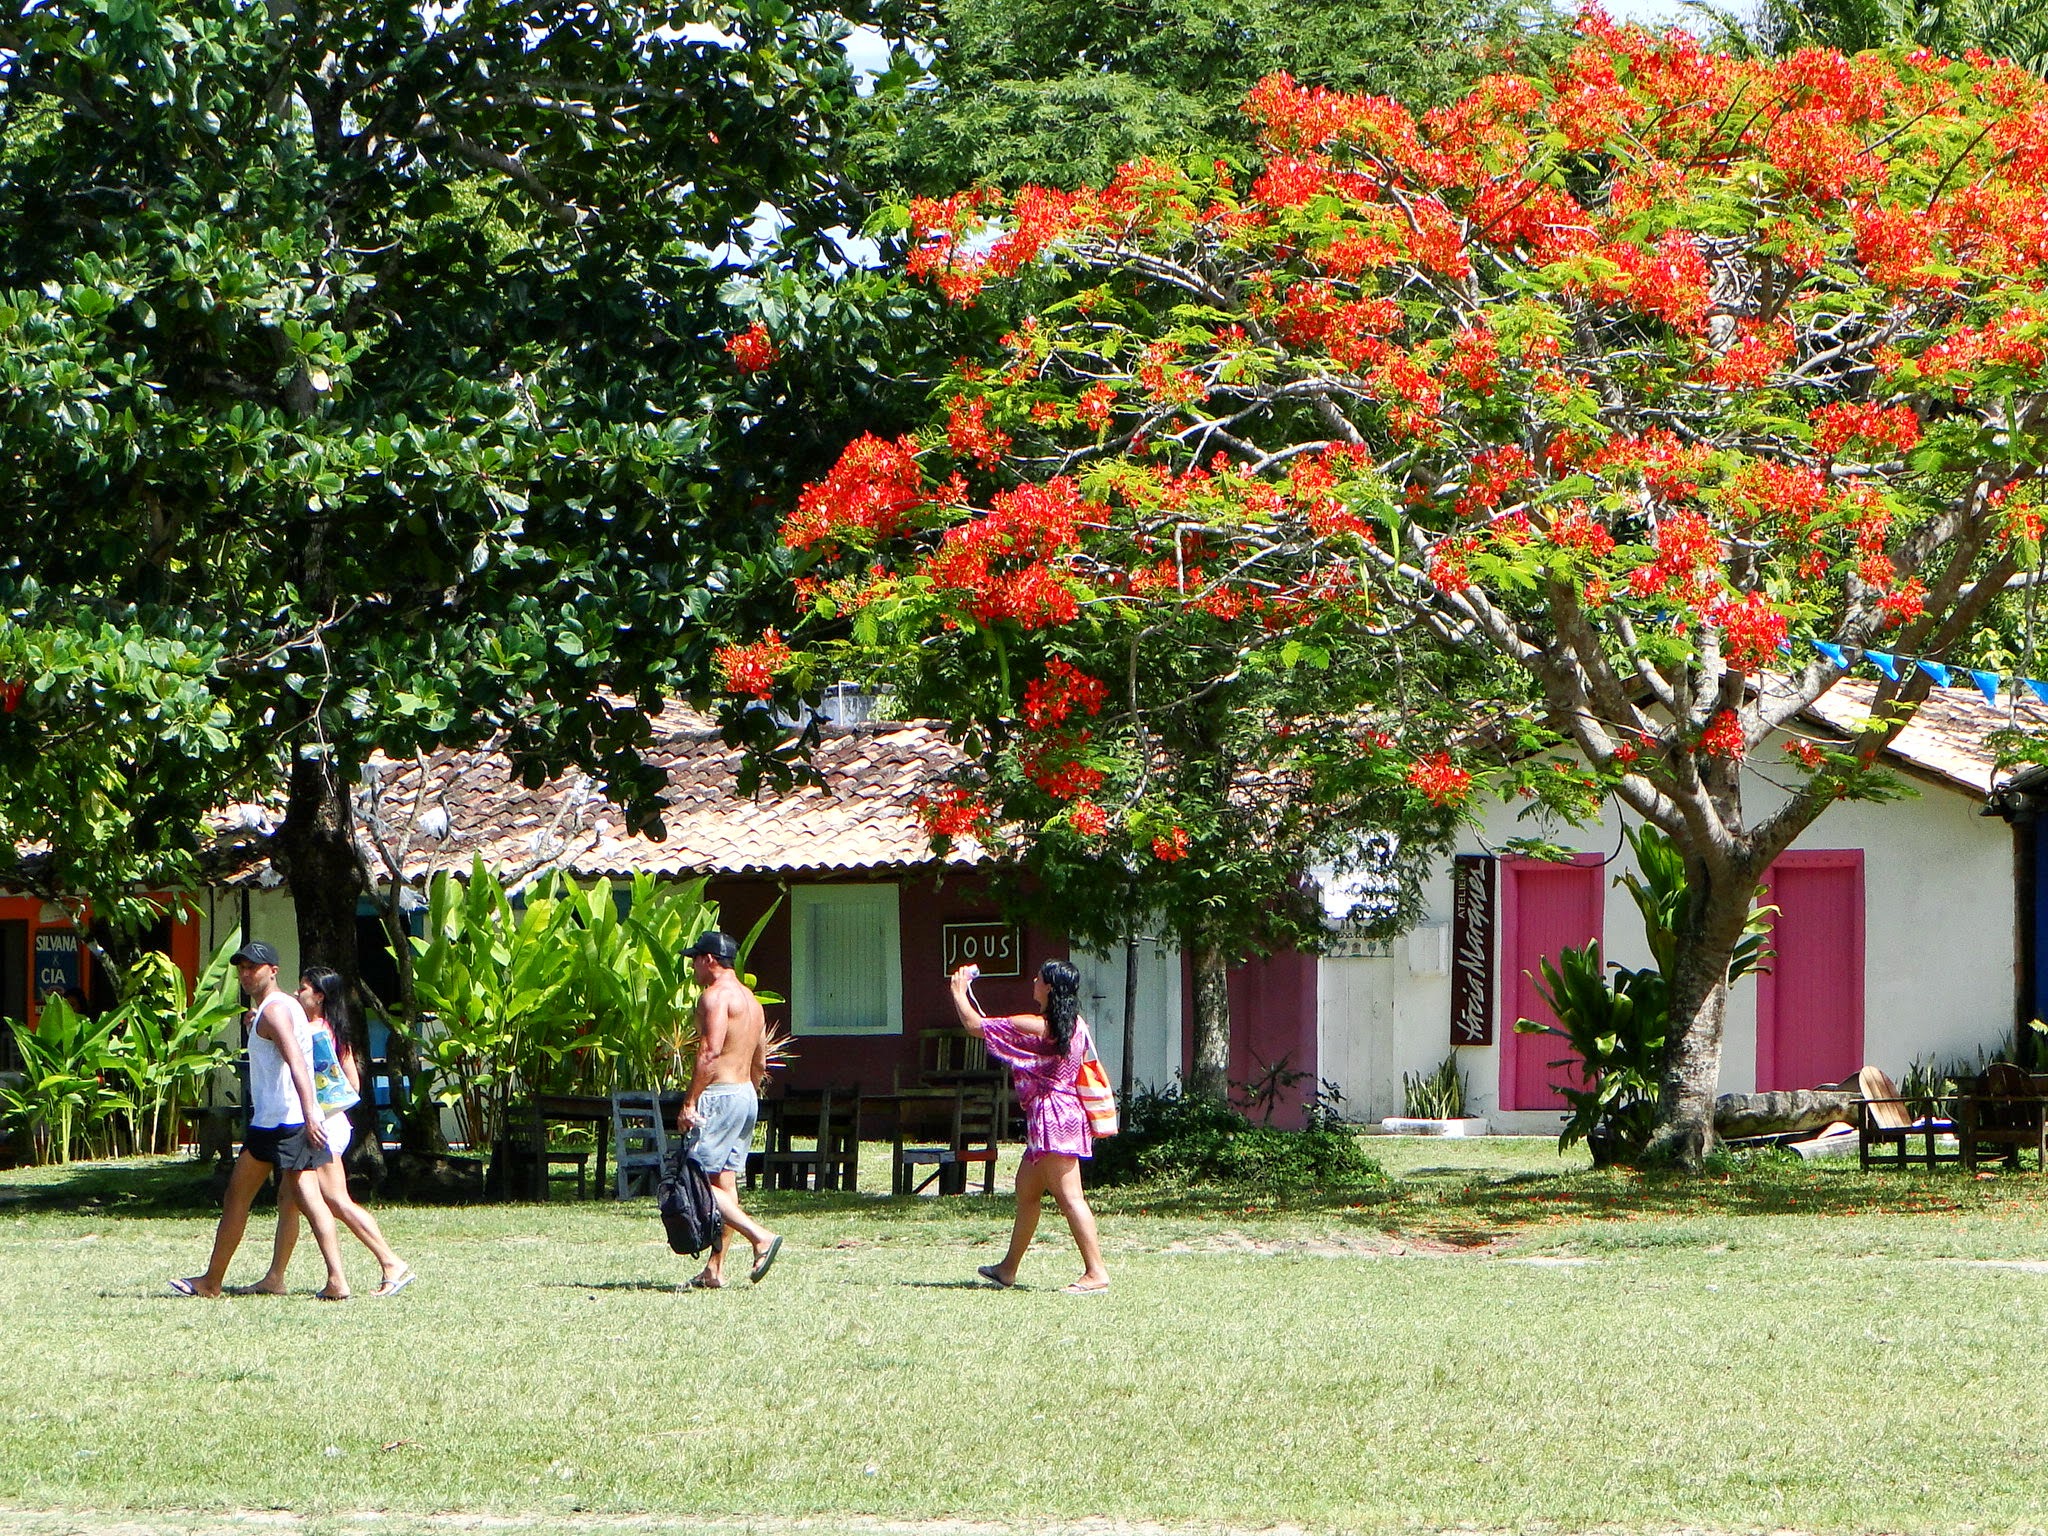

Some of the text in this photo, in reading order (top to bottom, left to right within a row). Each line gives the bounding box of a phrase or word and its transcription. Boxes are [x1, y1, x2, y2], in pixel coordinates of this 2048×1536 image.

[1457, 874, 1466, 919] ATELIER
[36, 936, 78, 952] SILVANA
[949, 934, 1010, 964] JOUS
[41, 968, 66, 984] CIA
